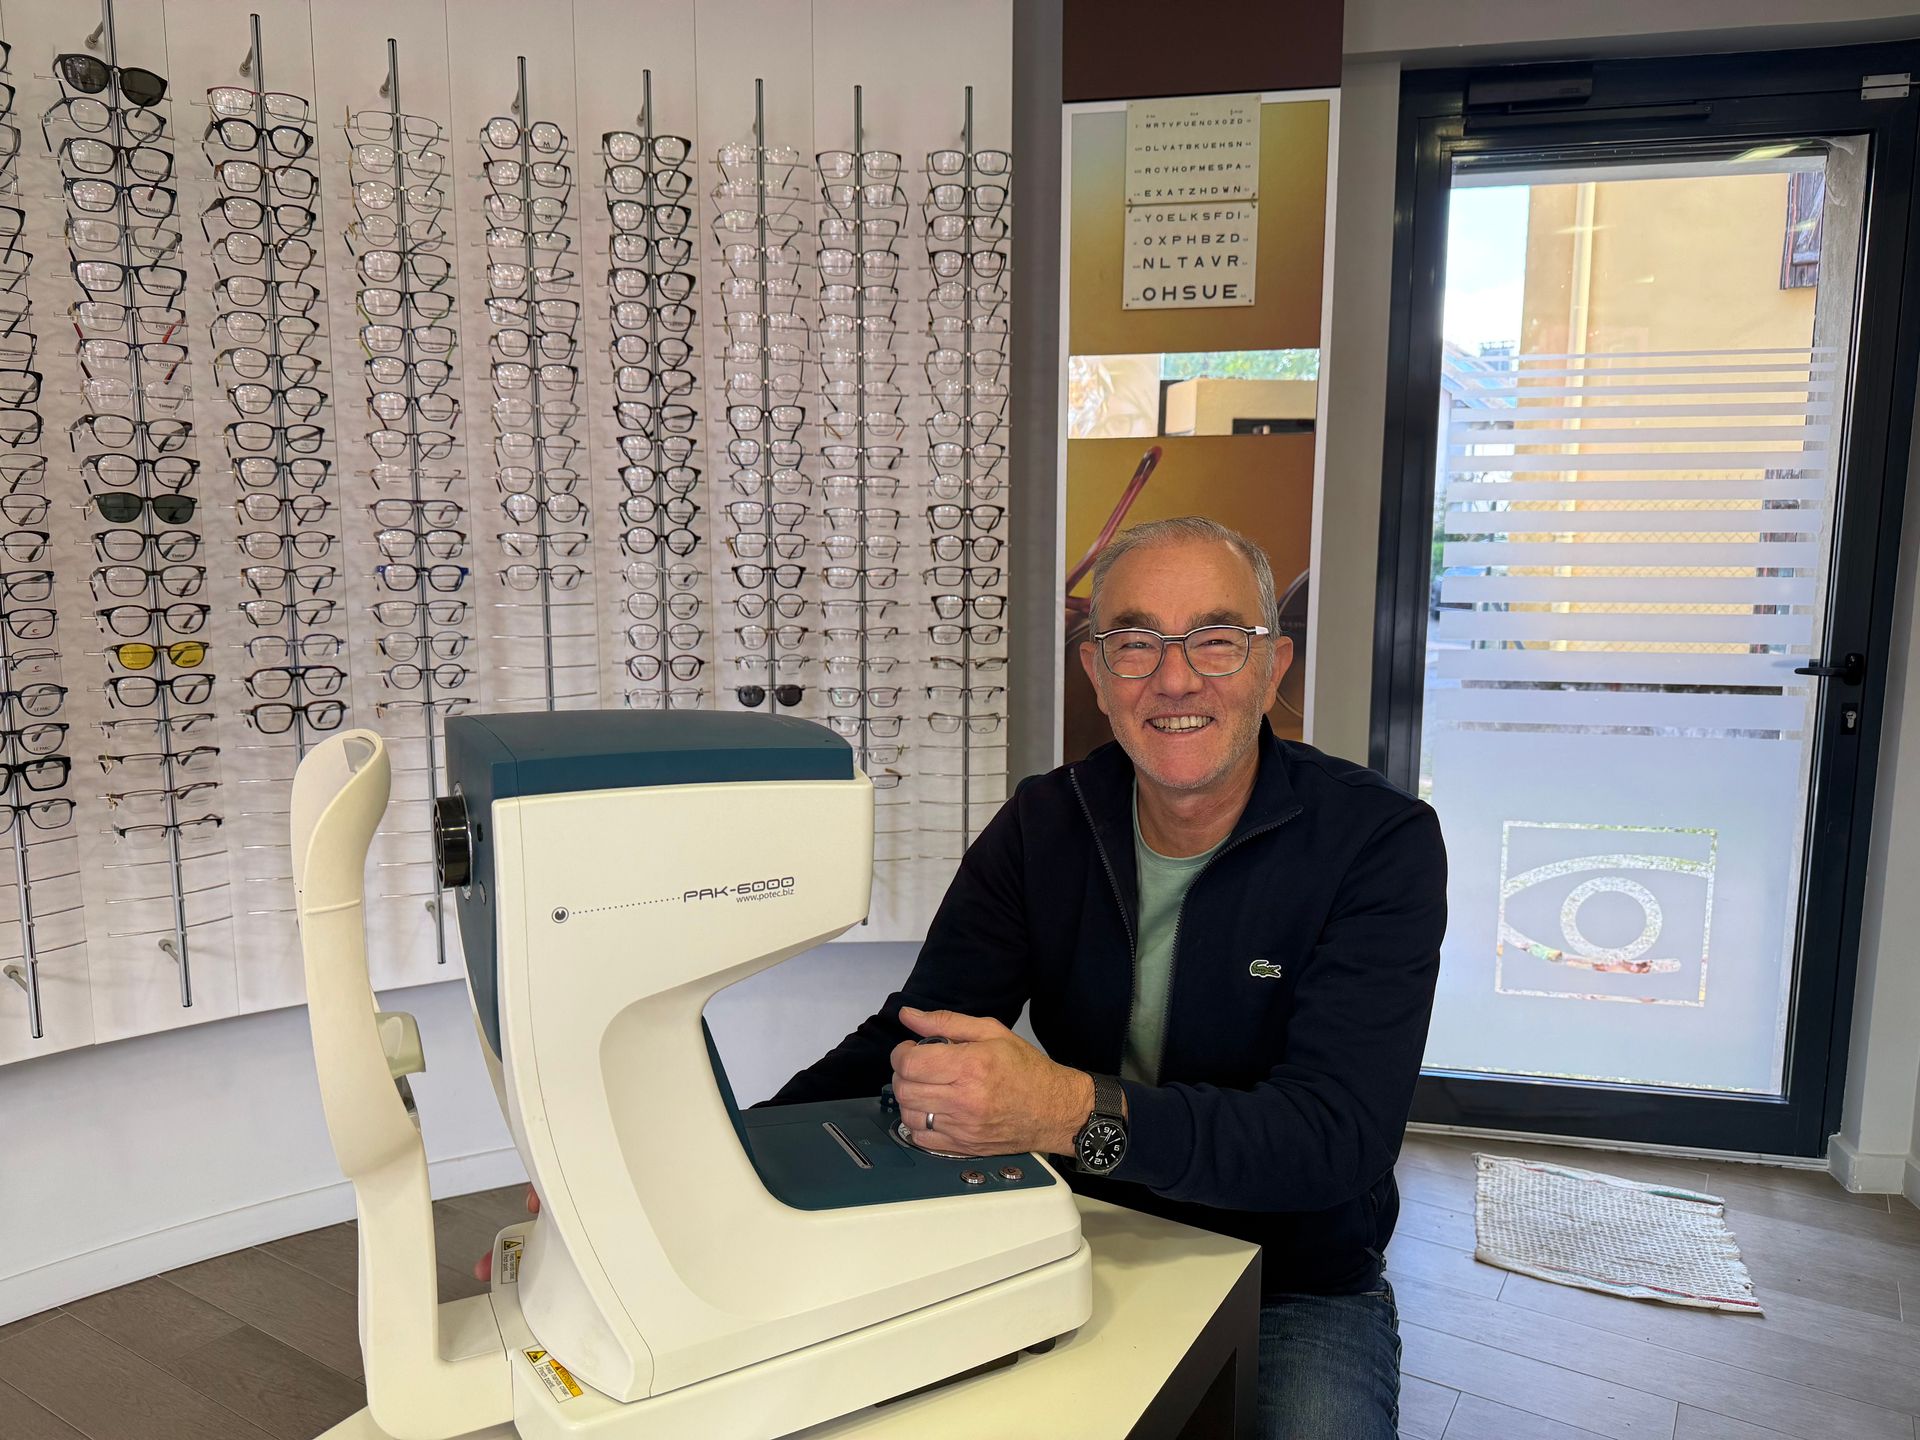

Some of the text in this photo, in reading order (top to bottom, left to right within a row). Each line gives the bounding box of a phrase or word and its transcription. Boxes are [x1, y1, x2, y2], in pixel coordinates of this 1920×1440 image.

[1143, 233, 1240, 246] OXPHBZD
[1142, 255, 1239, 270] NLTAVR
[1142, 284, 1238, 301] OHSUE
[684, 877, 795, 902] PAK-6000
[736, 889, 795, 903] www.potec.biz
